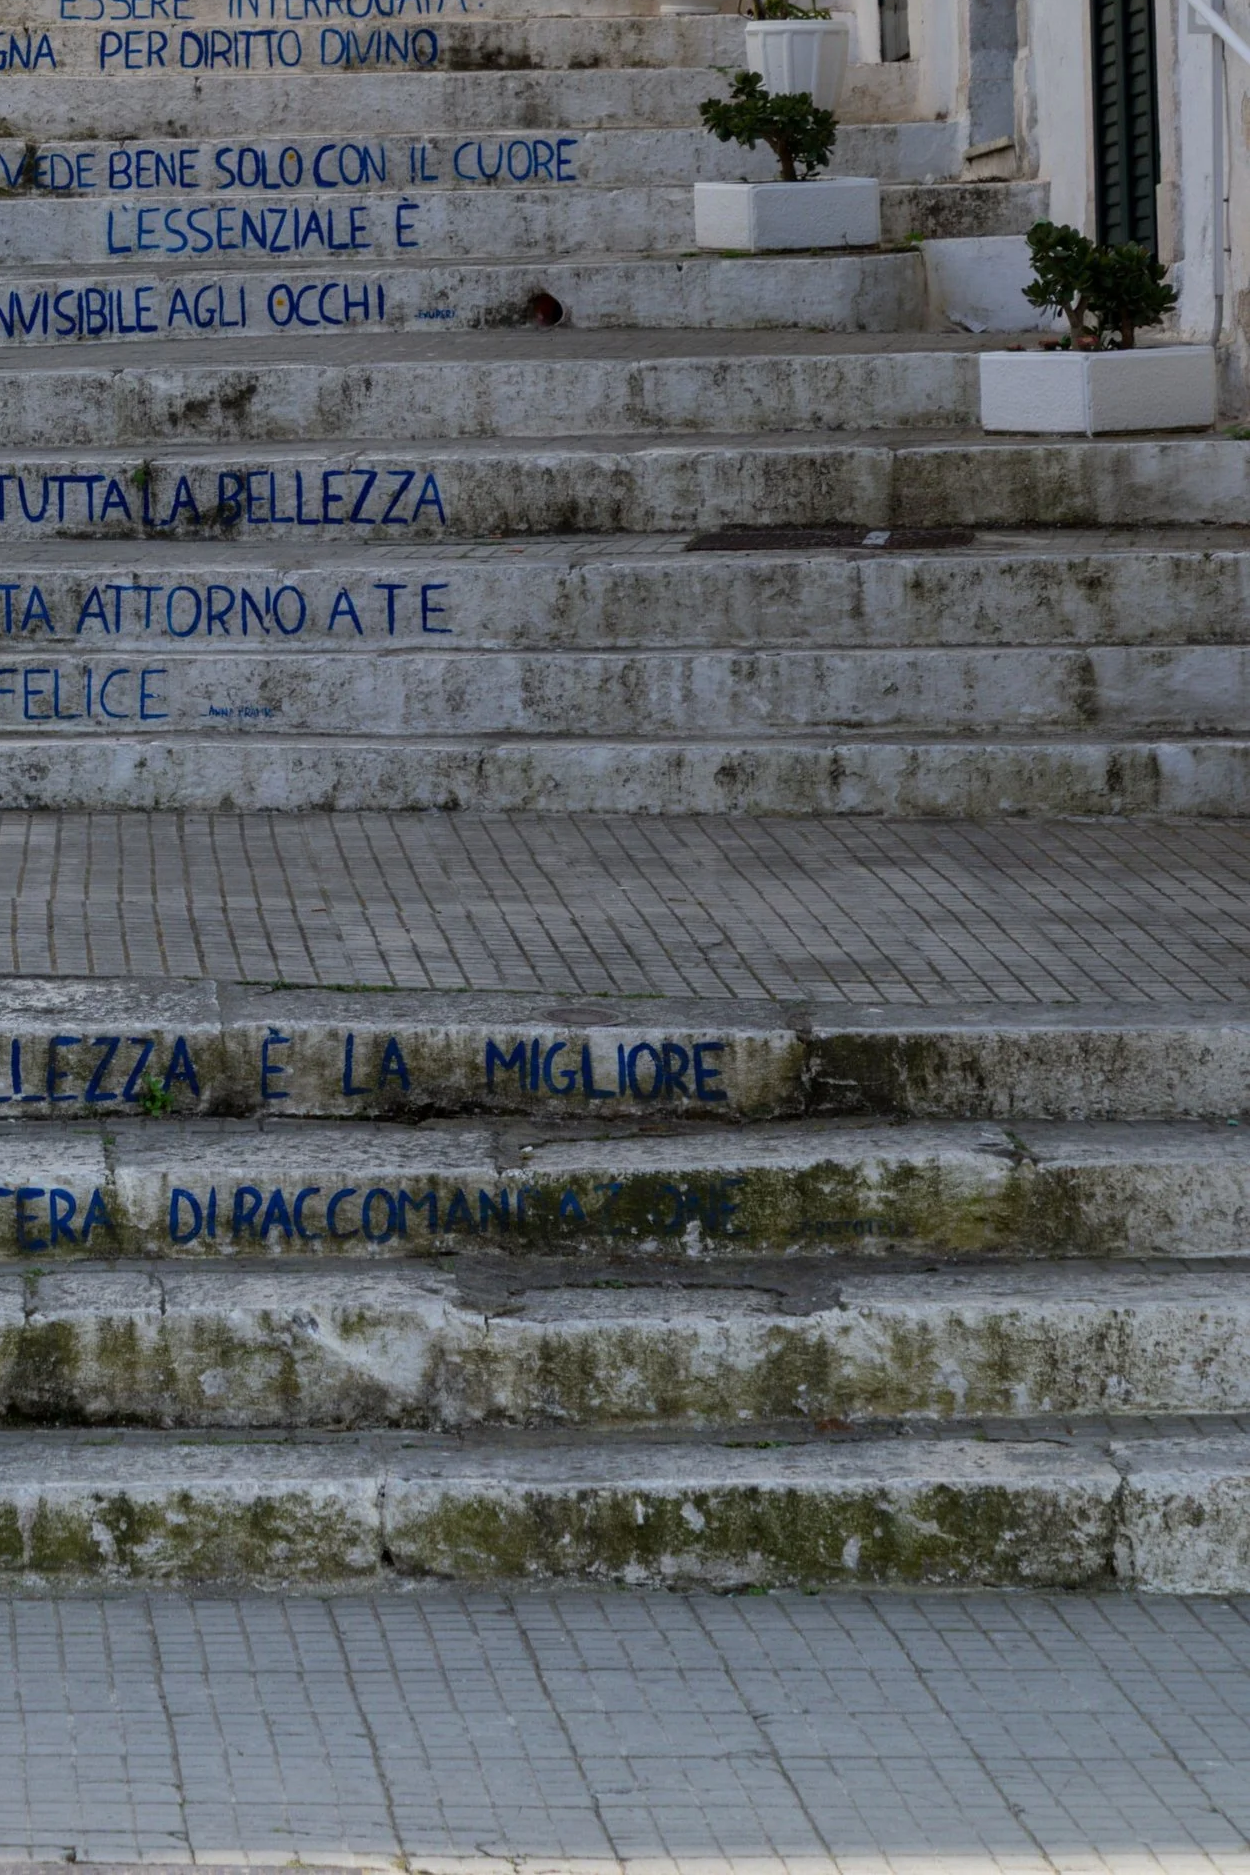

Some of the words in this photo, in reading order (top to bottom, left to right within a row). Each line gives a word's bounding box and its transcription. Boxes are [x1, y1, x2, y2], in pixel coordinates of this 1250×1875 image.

[100, 30, 168, 69] PER
[180, 29, 301, 69] DIRITTO
[321, 28, 438, 67] DIVINO
[109, 149, 200, 190] BENE
[215, 146, 303, 190] SOLO
[313, 143, 386, 188] CON
[410, 145, 438, 184] IL
[453, 139, 578, 182] CUORE
[396, 197, 420, 248] È
[168, 285, 246, 328] AGLI
[267, 283, 385, 326] OCCHI
[143, 475, 201, 526] LA
[217, 469, 446, 526] BELLEZZA
[76, 583, 307, 637] ATTORNO
[327, 586, 364, 636] A
[373, 583, 453, 636] TE
[261, 1027, 291, 1100] È
[342, 1032, 412, 1097] LA
[486, 1037, 727, 1102] MIGLIORE
[168, 1185, 217, 1244] DI
